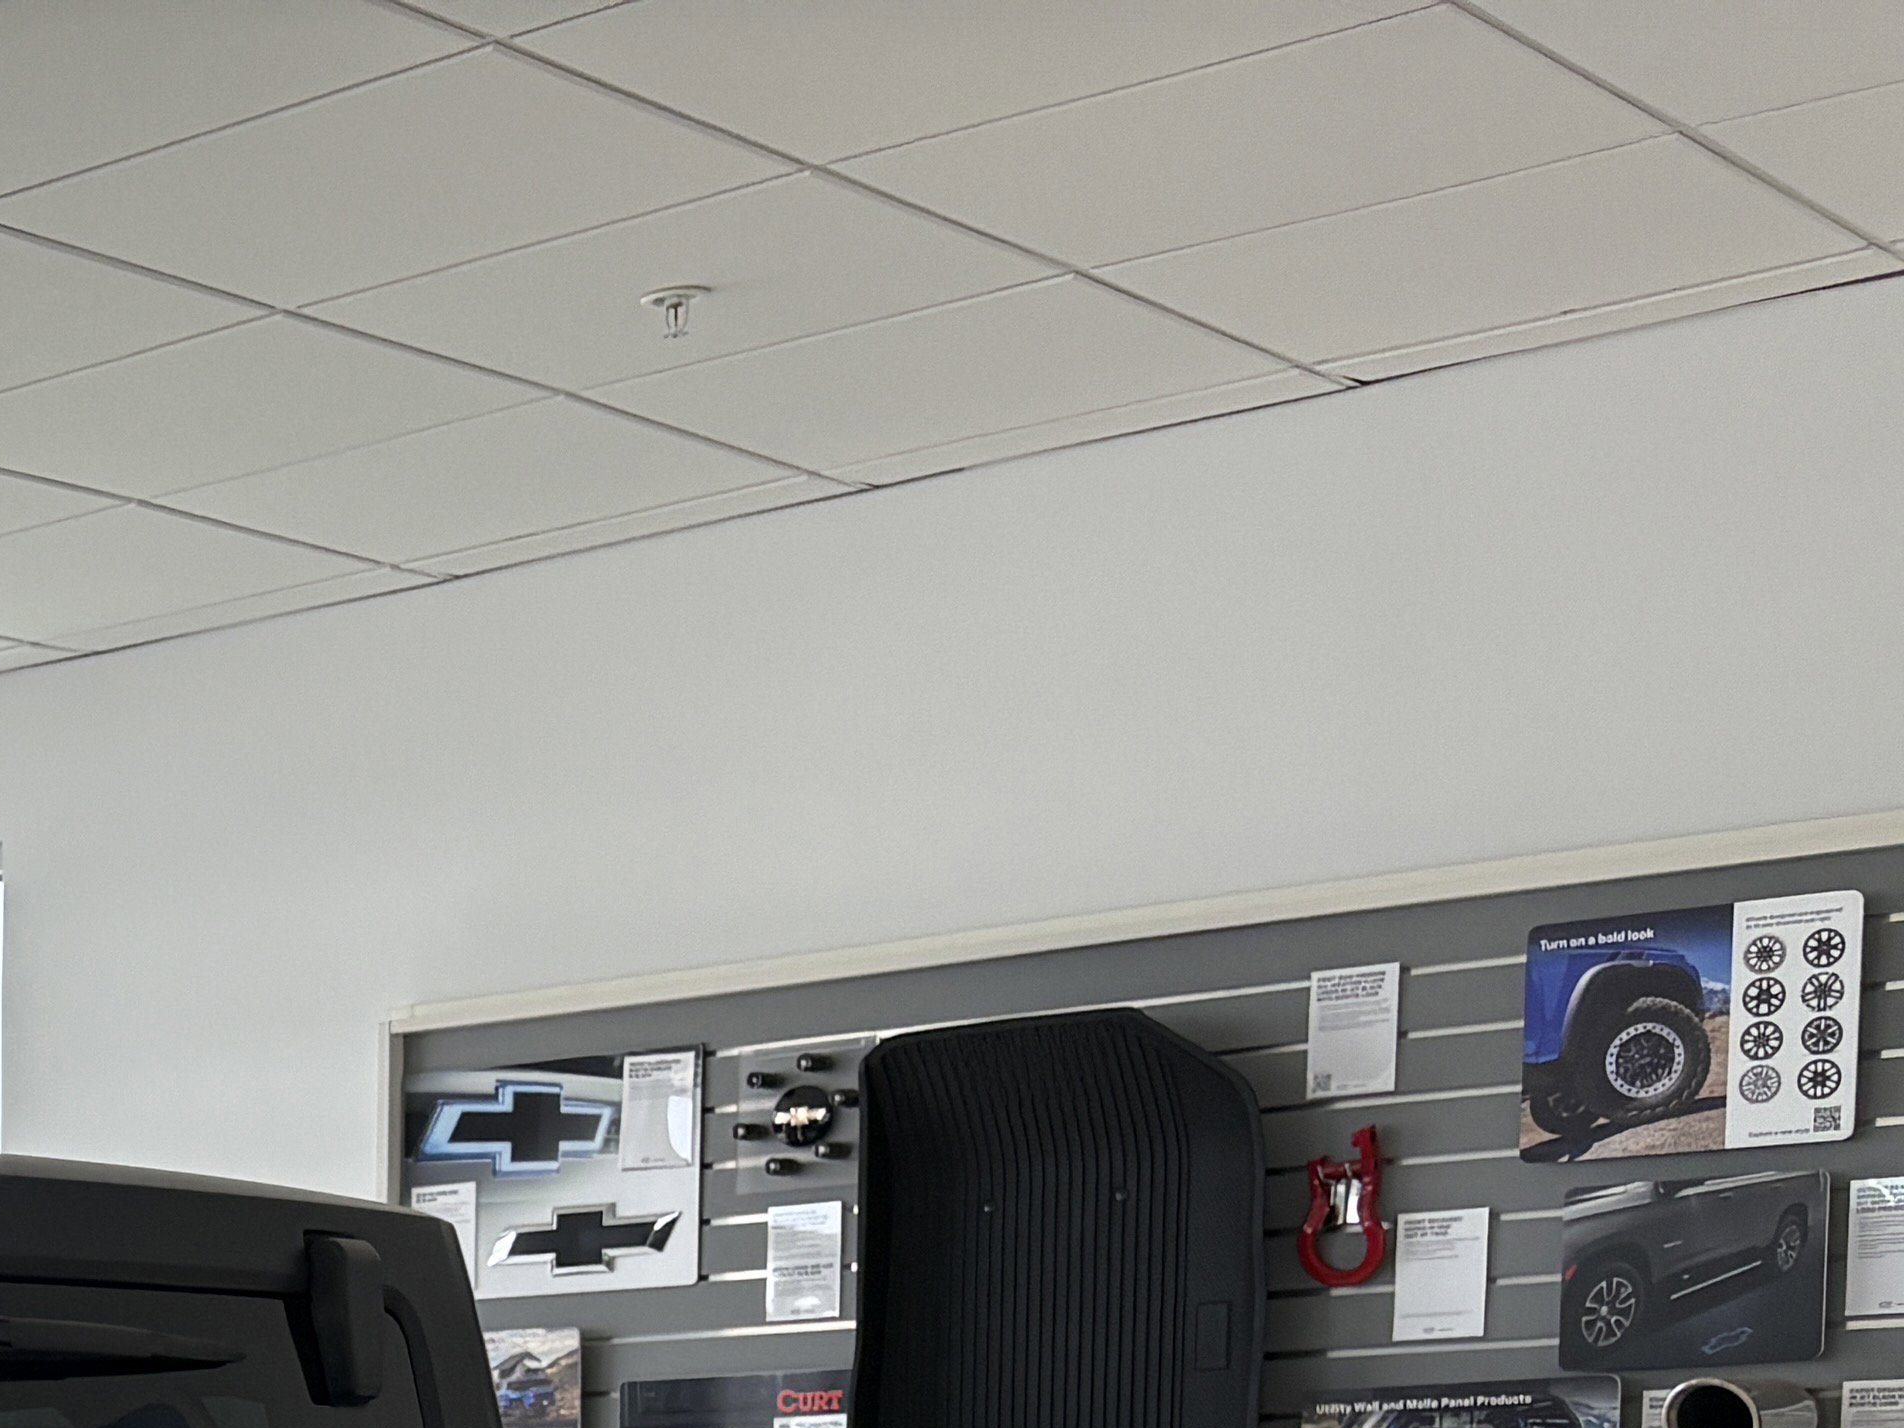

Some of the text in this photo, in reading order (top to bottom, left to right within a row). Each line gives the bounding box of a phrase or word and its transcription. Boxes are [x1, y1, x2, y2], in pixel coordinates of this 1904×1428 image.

[1539, 927, 1654, 951] Turn on a bold look
[776, 1388, 845, 1413] CURT
[1315, 1393, 1532, 1415] Utility Wall and Molle Panel Products
